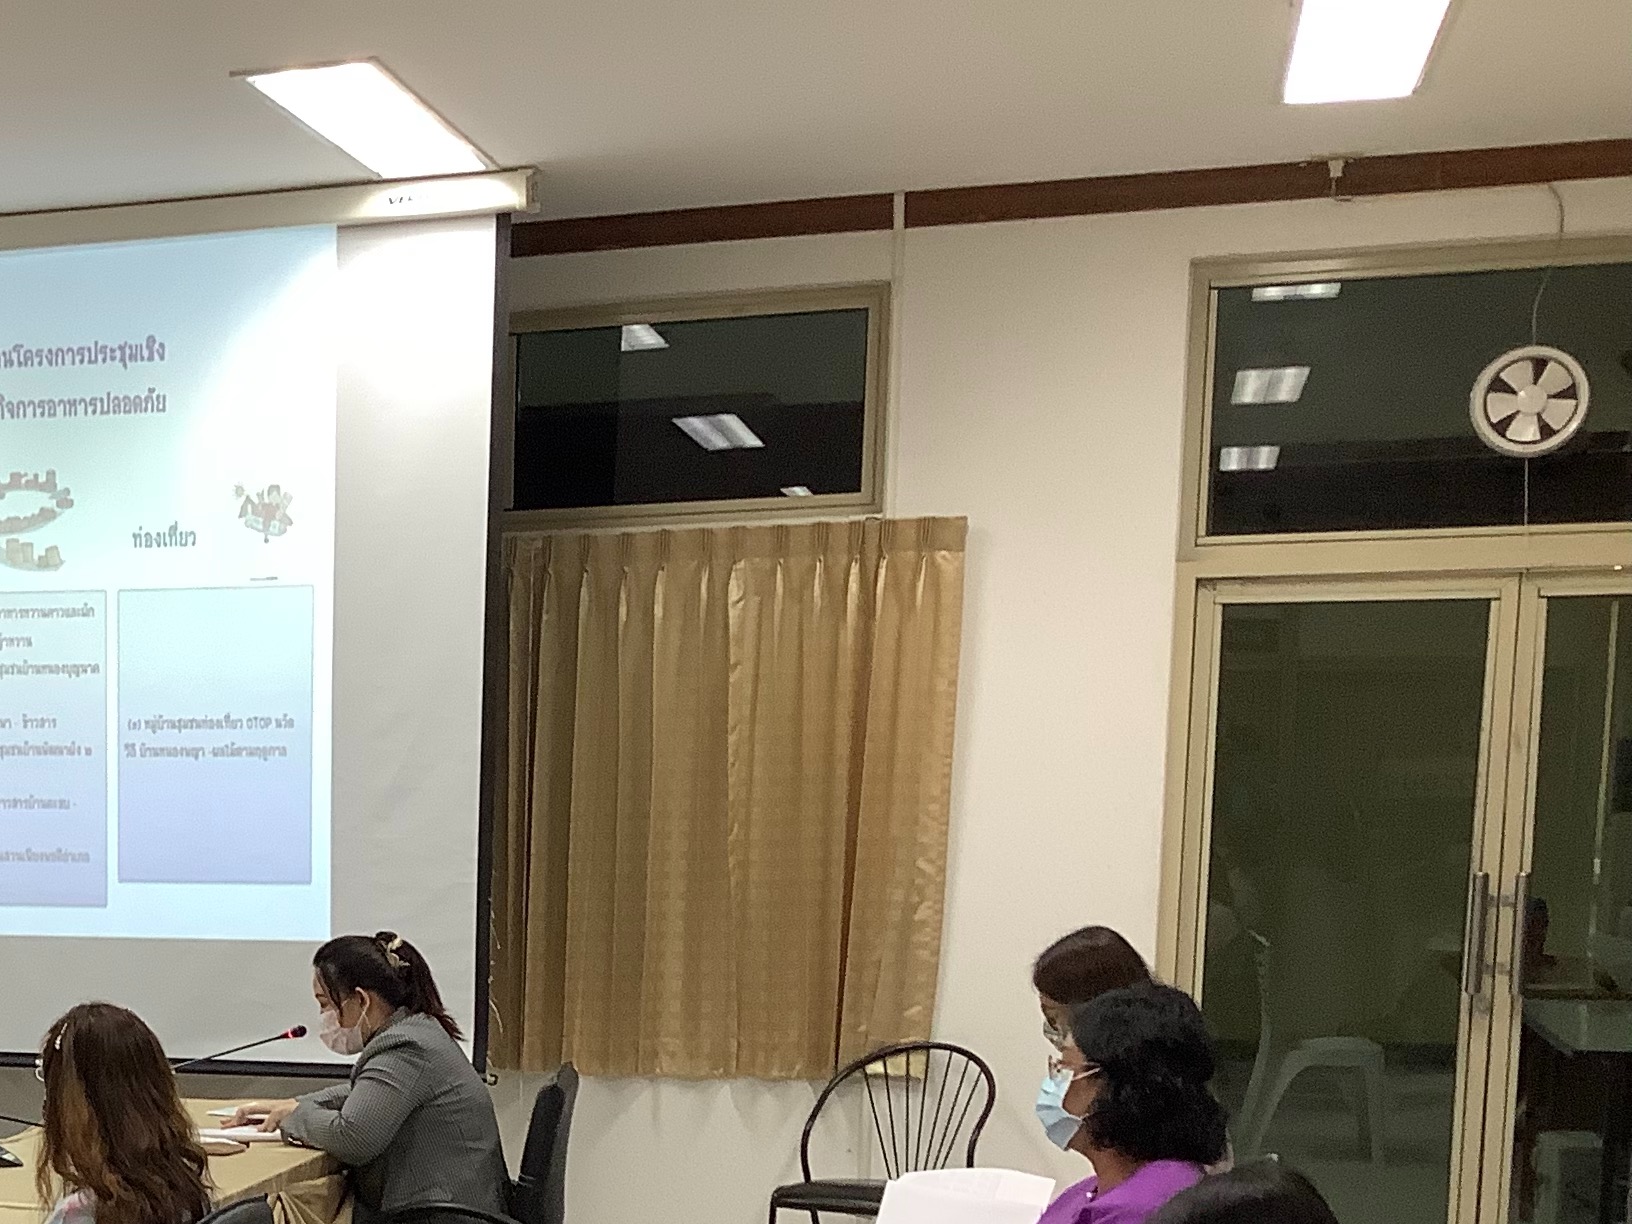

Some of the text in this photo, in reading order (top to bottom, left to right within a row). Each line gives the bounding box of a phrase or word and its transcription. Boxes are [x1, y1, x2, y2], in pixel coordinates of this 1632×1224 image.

[132, 520, 197, 548] ท่องเที่ยว
[246, 716, 272, 729] OTOP
